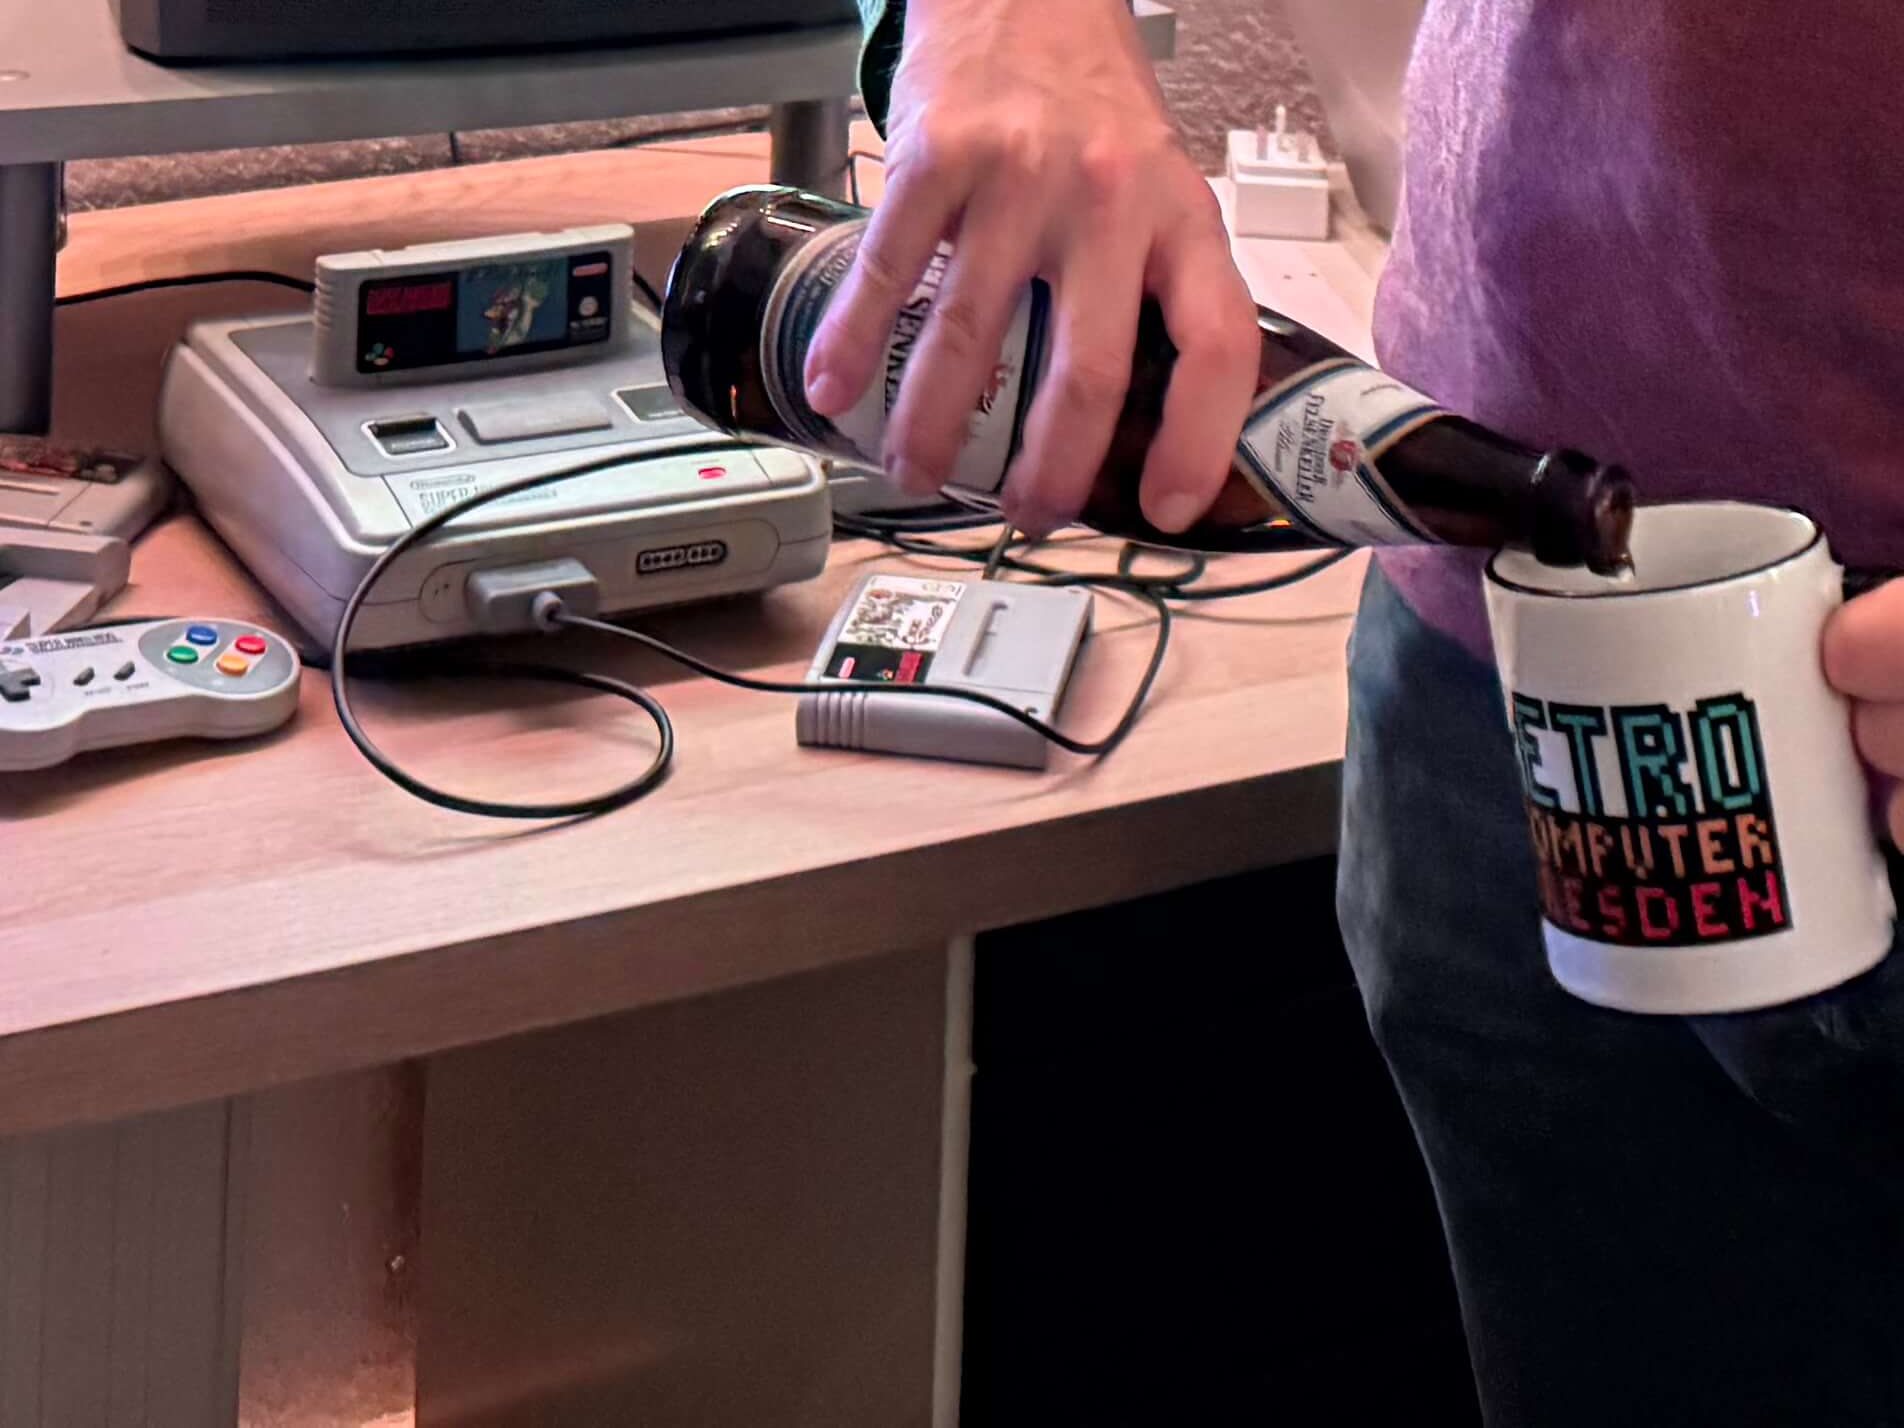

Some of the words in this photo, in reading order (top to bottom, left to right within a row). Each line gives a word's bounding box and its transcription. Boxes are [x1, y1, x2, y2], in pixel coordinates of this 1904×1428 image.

[1512, 702, 1761, 818] ETRO
[1528, 812, 1774, 880] OMPUTER
[1546, 870, 1786, 940] ESDEN
